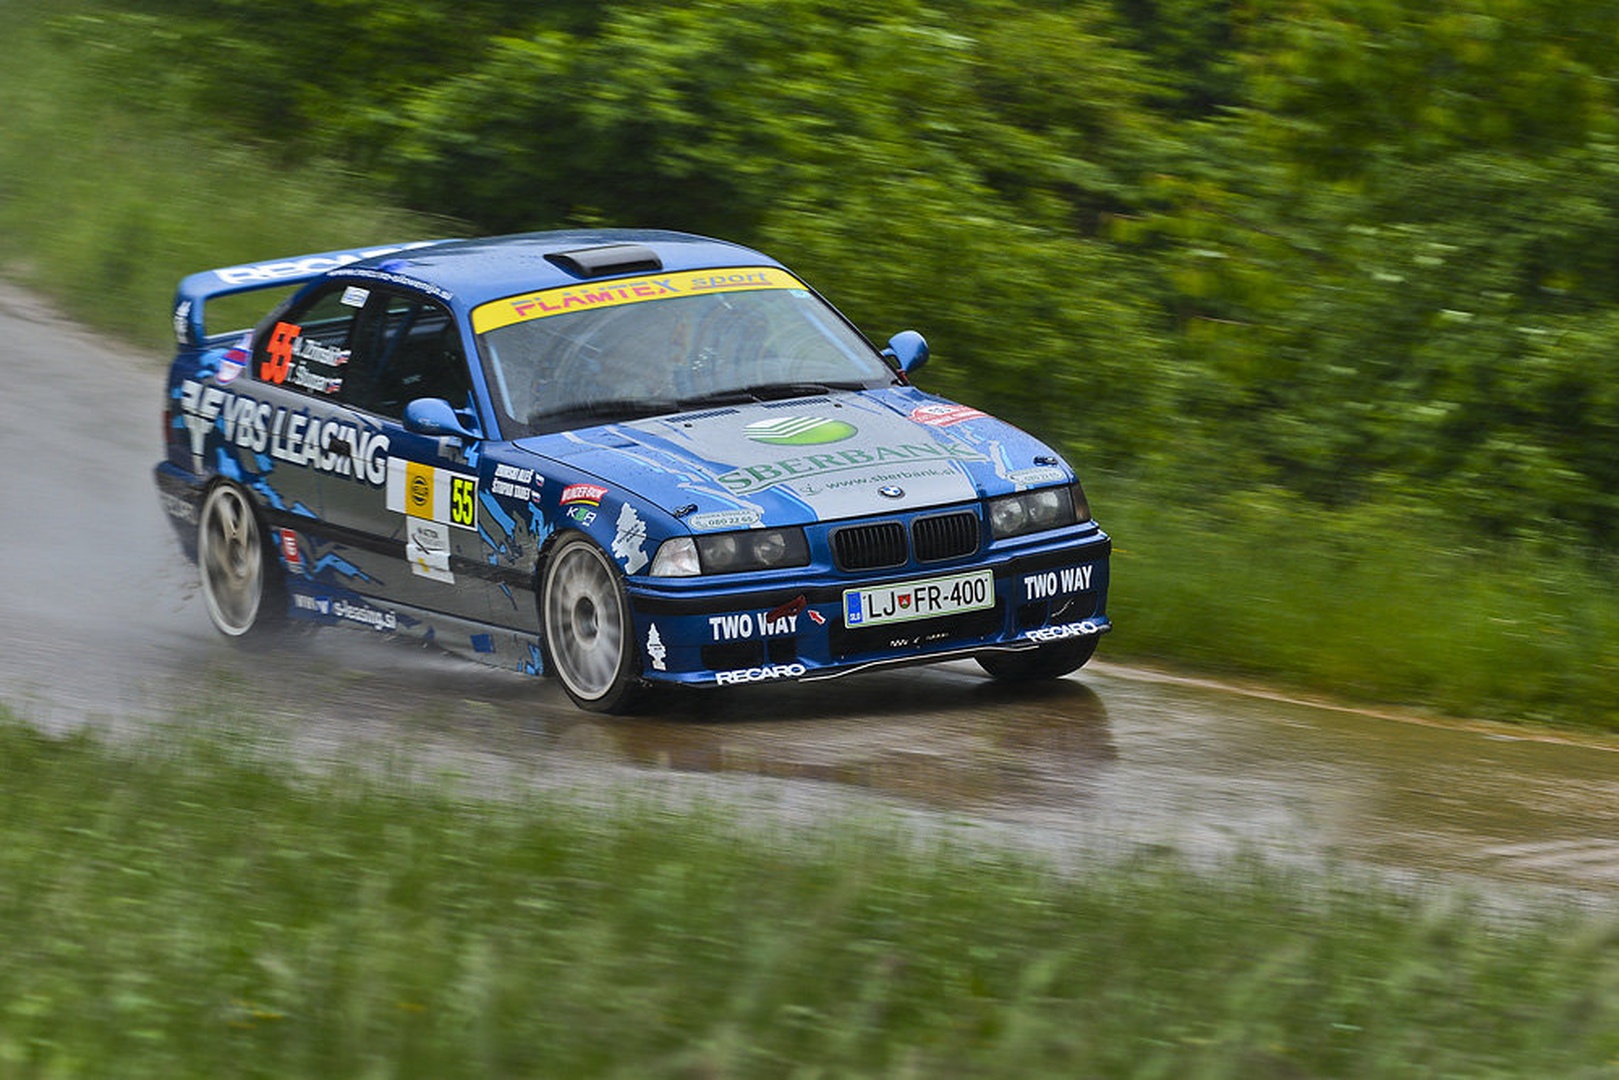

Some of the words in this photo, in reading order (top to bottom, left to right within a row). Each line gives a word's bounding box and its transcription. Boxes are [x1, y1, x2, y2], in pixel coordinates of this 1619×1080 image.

[691, 272, 768, 288] sport
[260, 321, 301, 385] 55
[222, 392, 273, 453] VBS
[271, 406, 391, 486] LEASING
[718, 442, 979, 490] SBERBANK
[826, 466, 955, 489] www.sberbank.si
[452, 478, 473, 525] 55
[867, 591, 897, 619] LJ
[913, 578, 986, 613] FR-400
[1024, 571, 1058, 600] TWO
[1060, 565, 1094, 594] WAY
[709, 613, 754, 640] TWO
[757, 611, 799, 636] WAY
[1025, 621, 1099, 643] RECARO
[715, 663, 806, 686] RECARO
